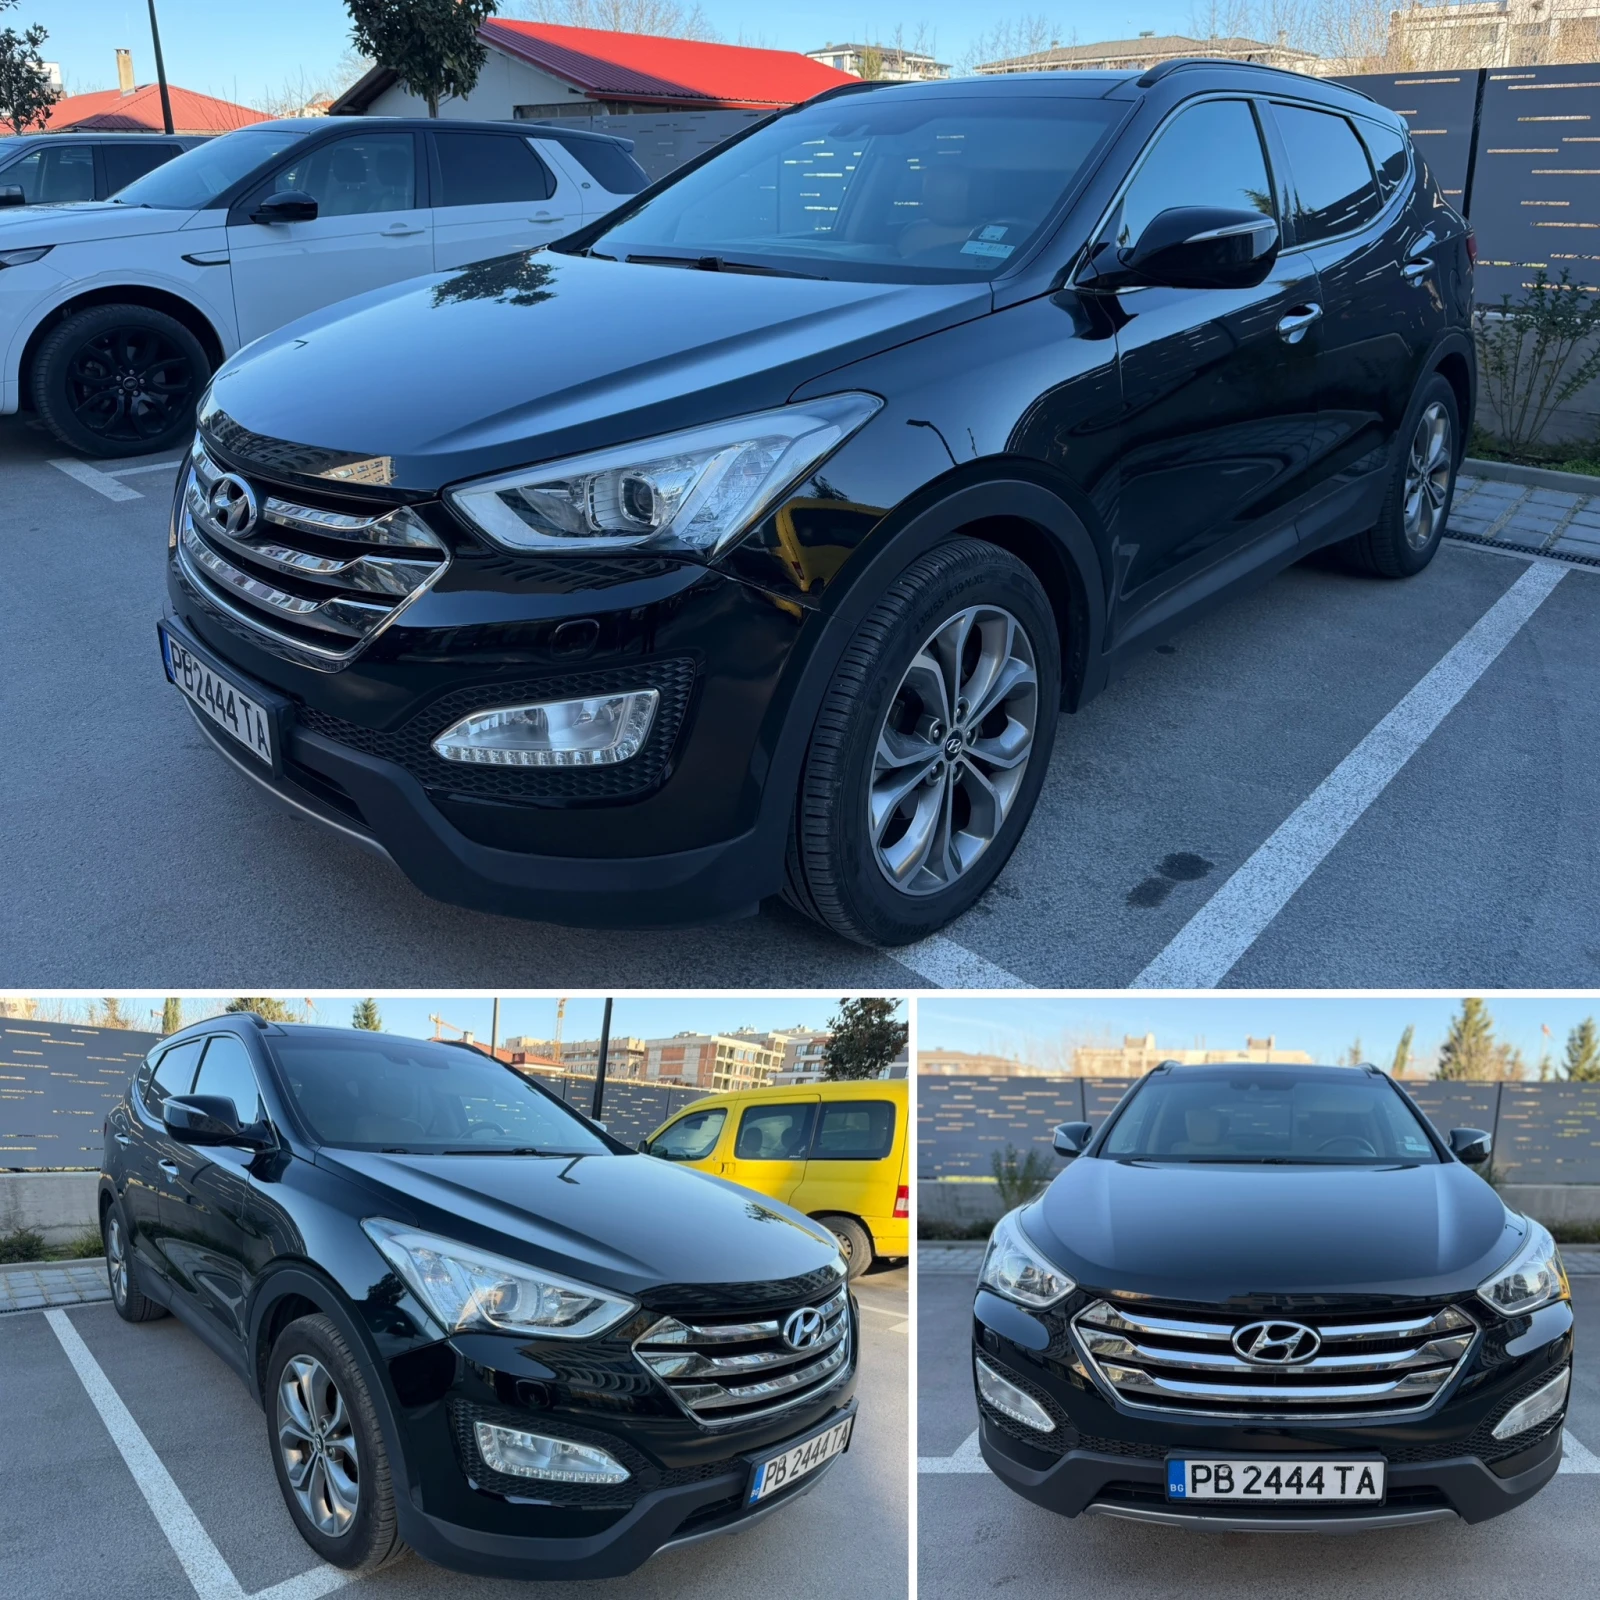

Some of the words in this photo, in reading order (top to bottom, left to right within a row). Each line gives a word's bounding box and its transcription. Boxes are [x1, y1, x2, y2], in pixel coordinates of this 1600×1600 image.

[912, 595, 945, 634] 235/55
[953, 582, 965, 595] 19
[974, 573, 986, 585] XL
[169, 640, 194, 691] PB
[194, 662, 239, 733] 2444
[239, 696, 271, 758] TA
[763, 1455, 787, 1493] PB
[789, 1432, 831, 1478] 2444
[831, 1421, 849, 1453] TA
[1170, 1483, 1184, 1492] BG
[1191, 1463, 1235, 1494] PB
[1242, 1465, 1325, 1495] 2444
[1333, 1466, 1376, 1495] TA
